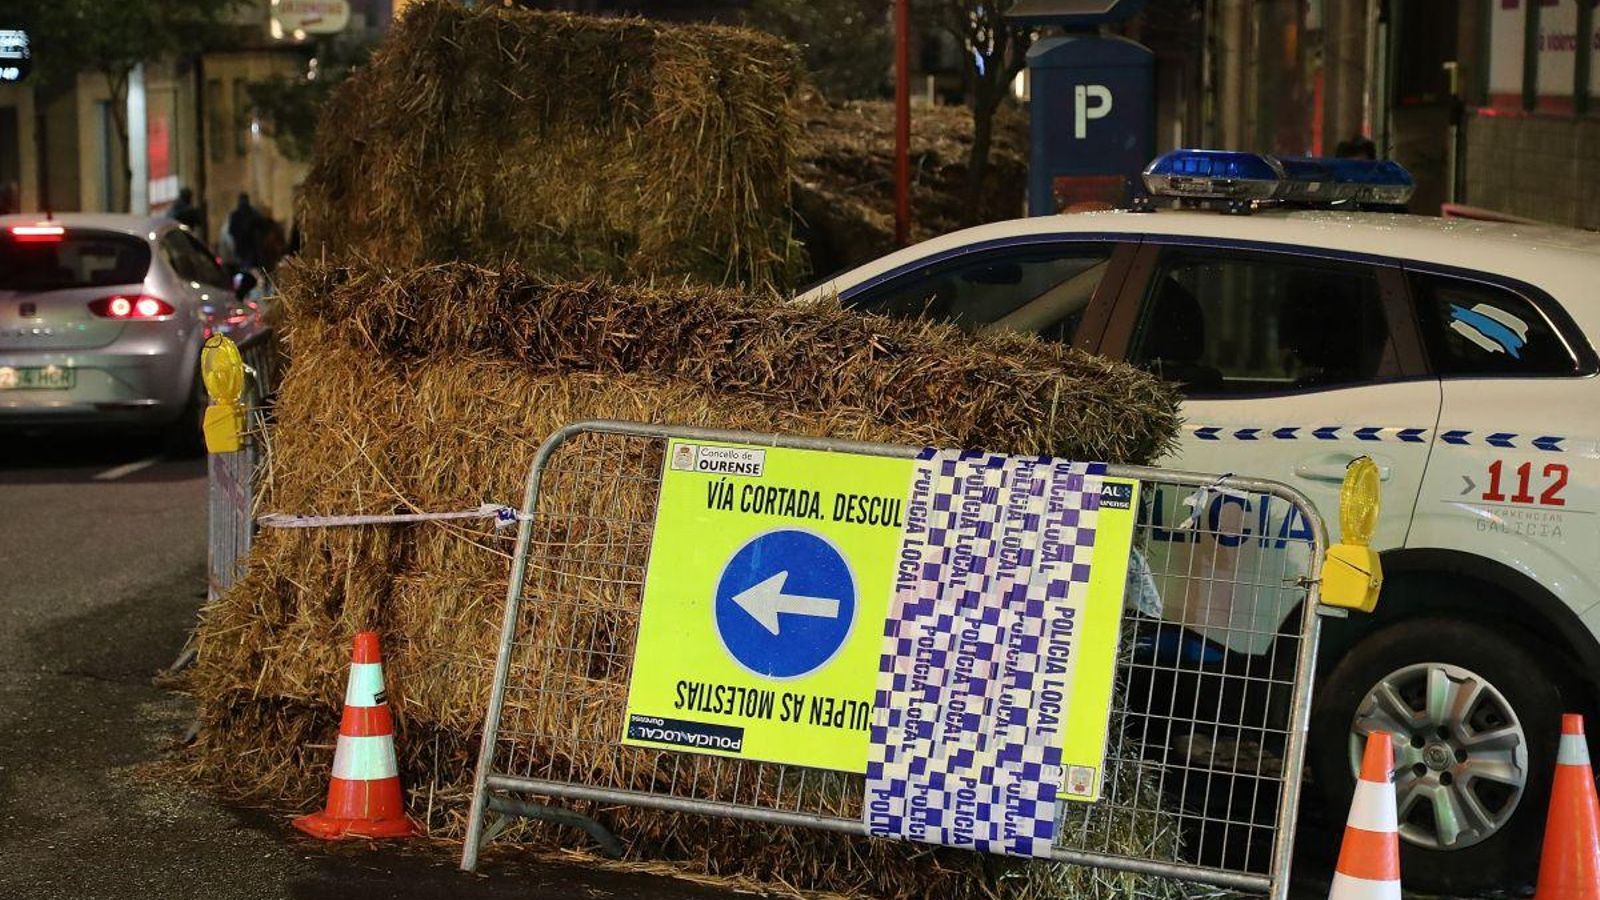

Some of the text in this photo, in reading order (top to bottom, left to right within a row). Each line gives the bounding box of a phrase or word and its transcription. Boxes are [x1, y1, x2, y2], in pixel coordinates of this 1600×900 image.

[1075, 84, 1112, 139] P
[699, 459, 760, 475] OURENSE
[701, 448, 753, 460] Concello de
[707, 477, 734, 511] VÍA
[740, 485, 824, 520] CORTADA.
[1482, 460, 1568, 506] 112
[1476, 519, 1562, 537] GALICIA
[896, 540, 924, 592] LOCAL
[942, 617, 983, 745] POLICIA LOCAL
[1036, 606, 1075, 736] POLICIA LOCAL
[674, 680, 775, 719] MOLESTIAS
[780, 692, 806, 722] AS
[631, 715, 665, 726] Ourense
[638, 727, 680, 743] LOCAL
[953, 777, 977, 845] POLICIA
